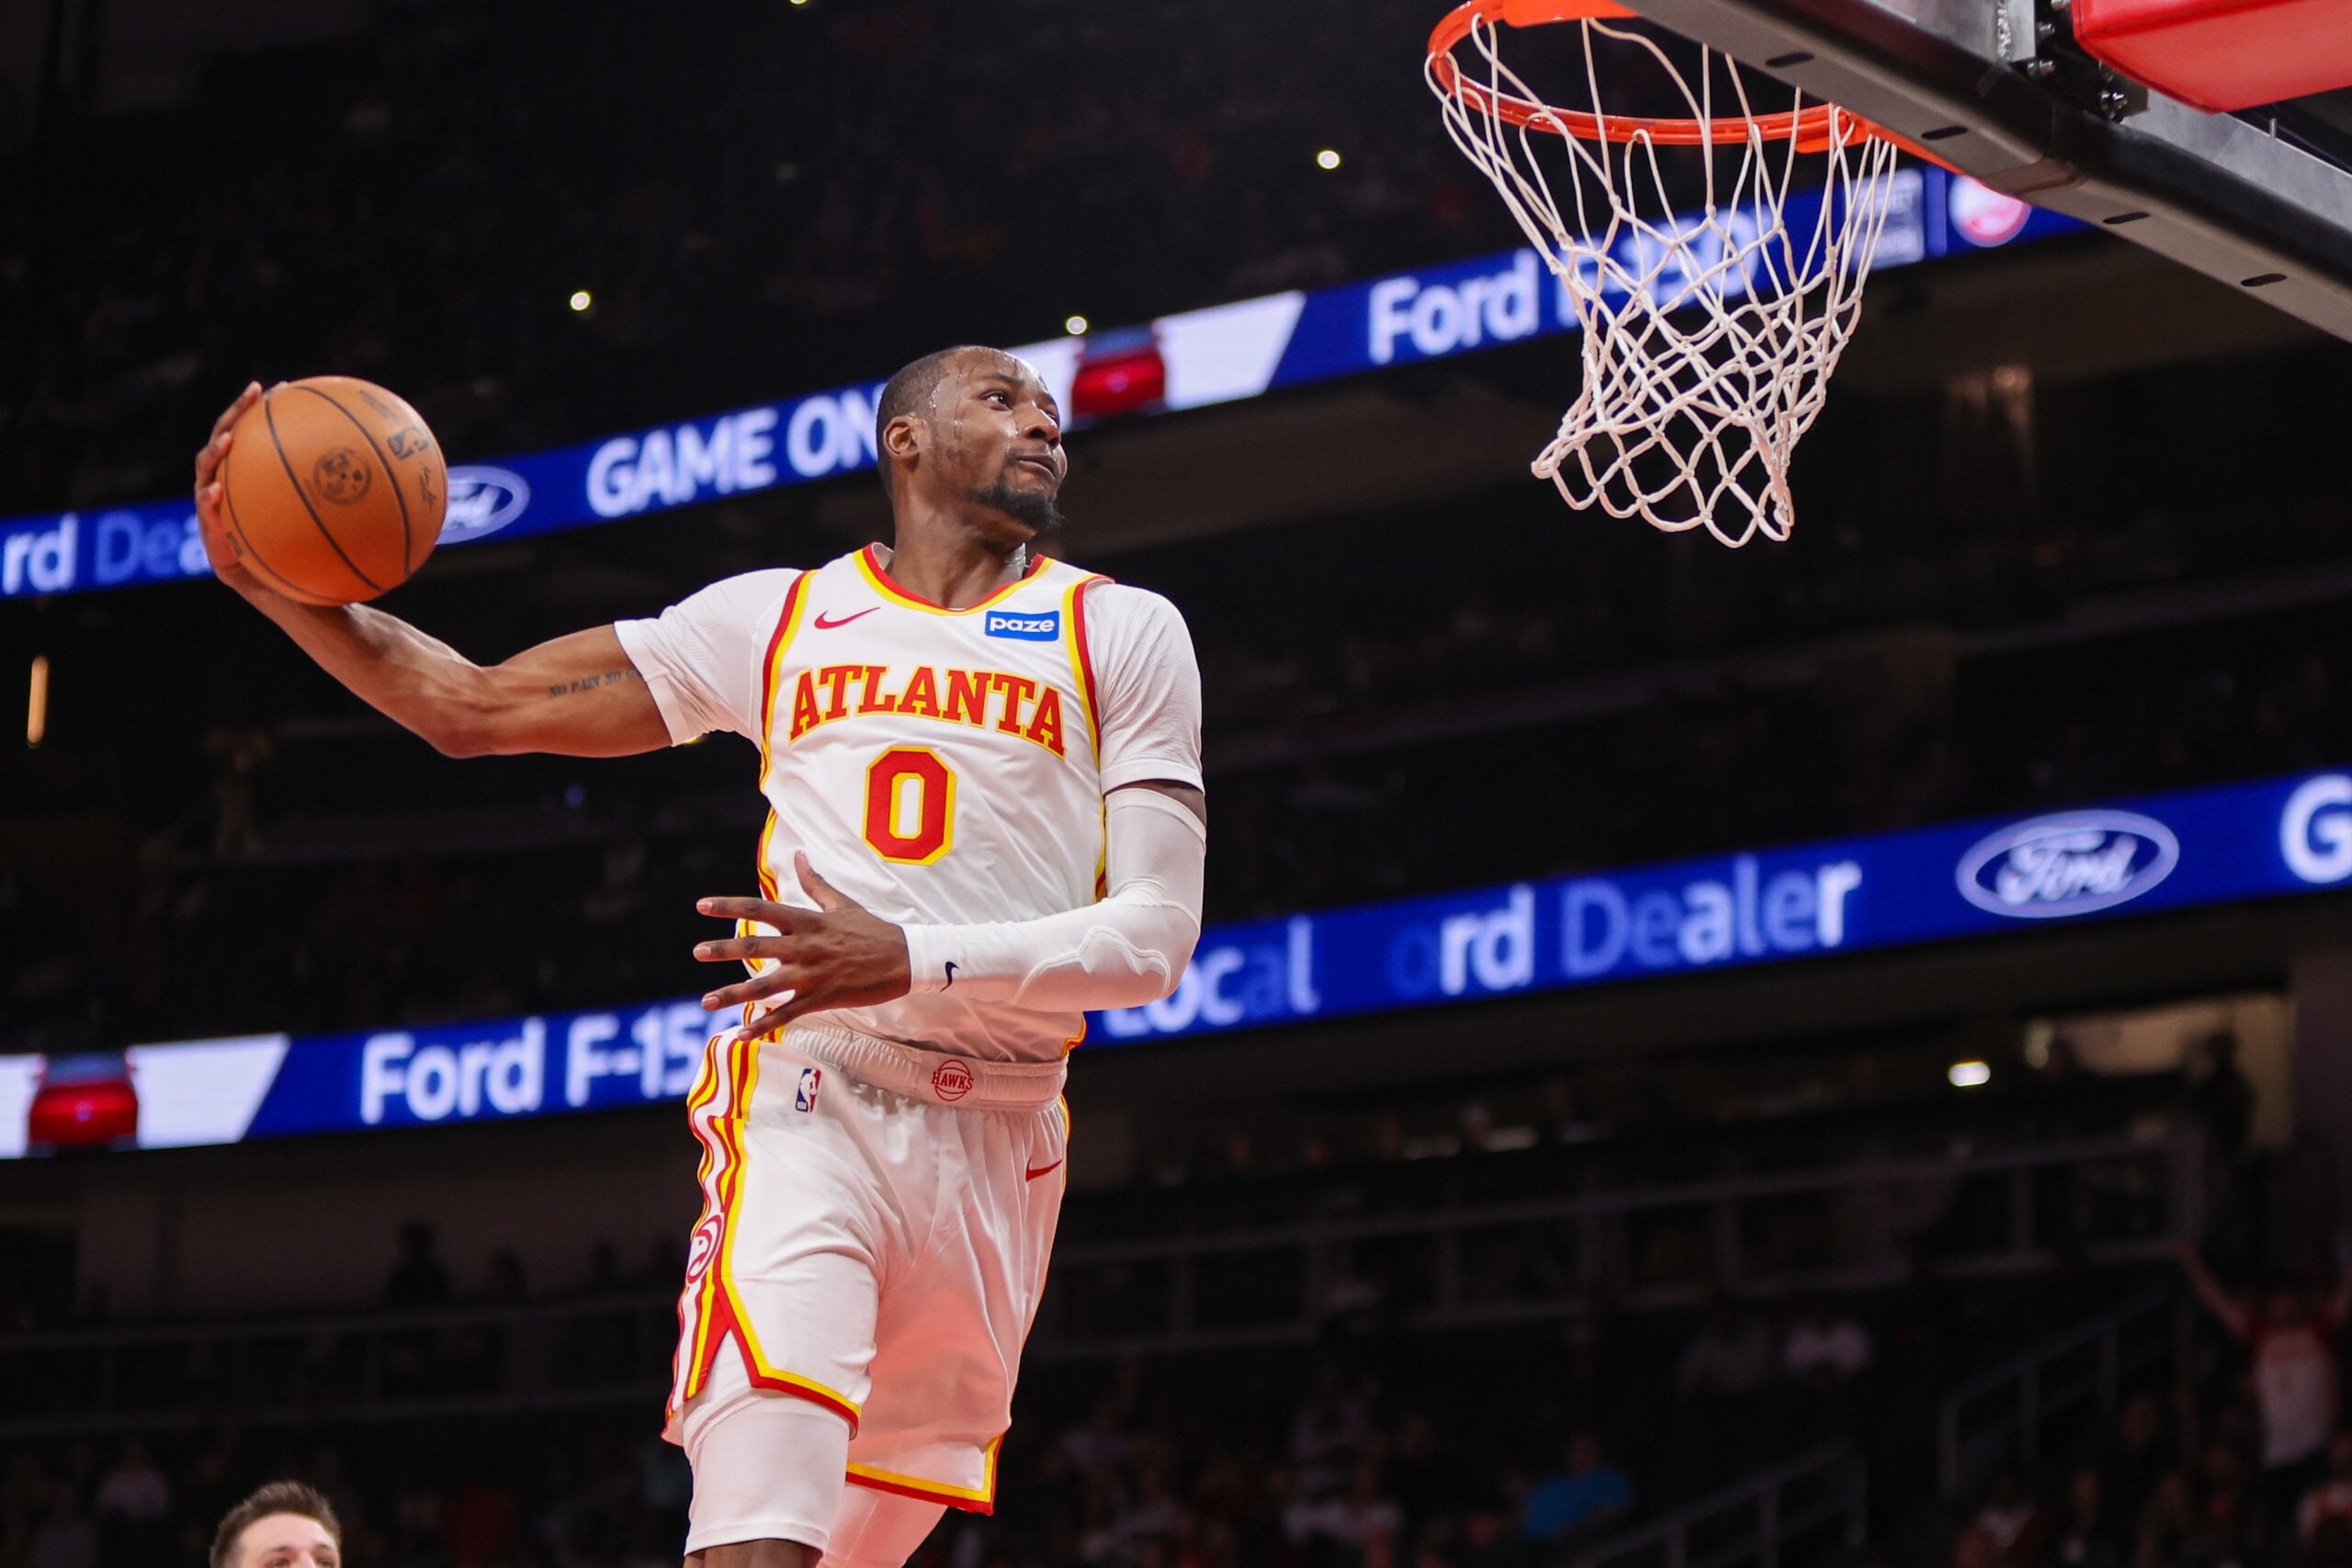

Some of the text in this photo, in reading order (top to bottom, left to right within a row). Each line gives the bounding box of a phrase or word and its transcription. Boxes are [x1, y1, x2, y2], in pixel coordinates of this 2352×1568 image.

[1369, 248, 1538, 364] Ford
[586, 406, 778, 518] GAME
[989, 616, 1055, 633] paze
[788, 663, 1068, 761] ATLANTA
[862, 746, 956, 866] 0
[1562, 852, 1863, 976] Dealer
[1996, 824, 2138, 907] Ford
[360, 1016, 547, 1124] Ford
[931, 1071, 974, 1091] HAWKS
